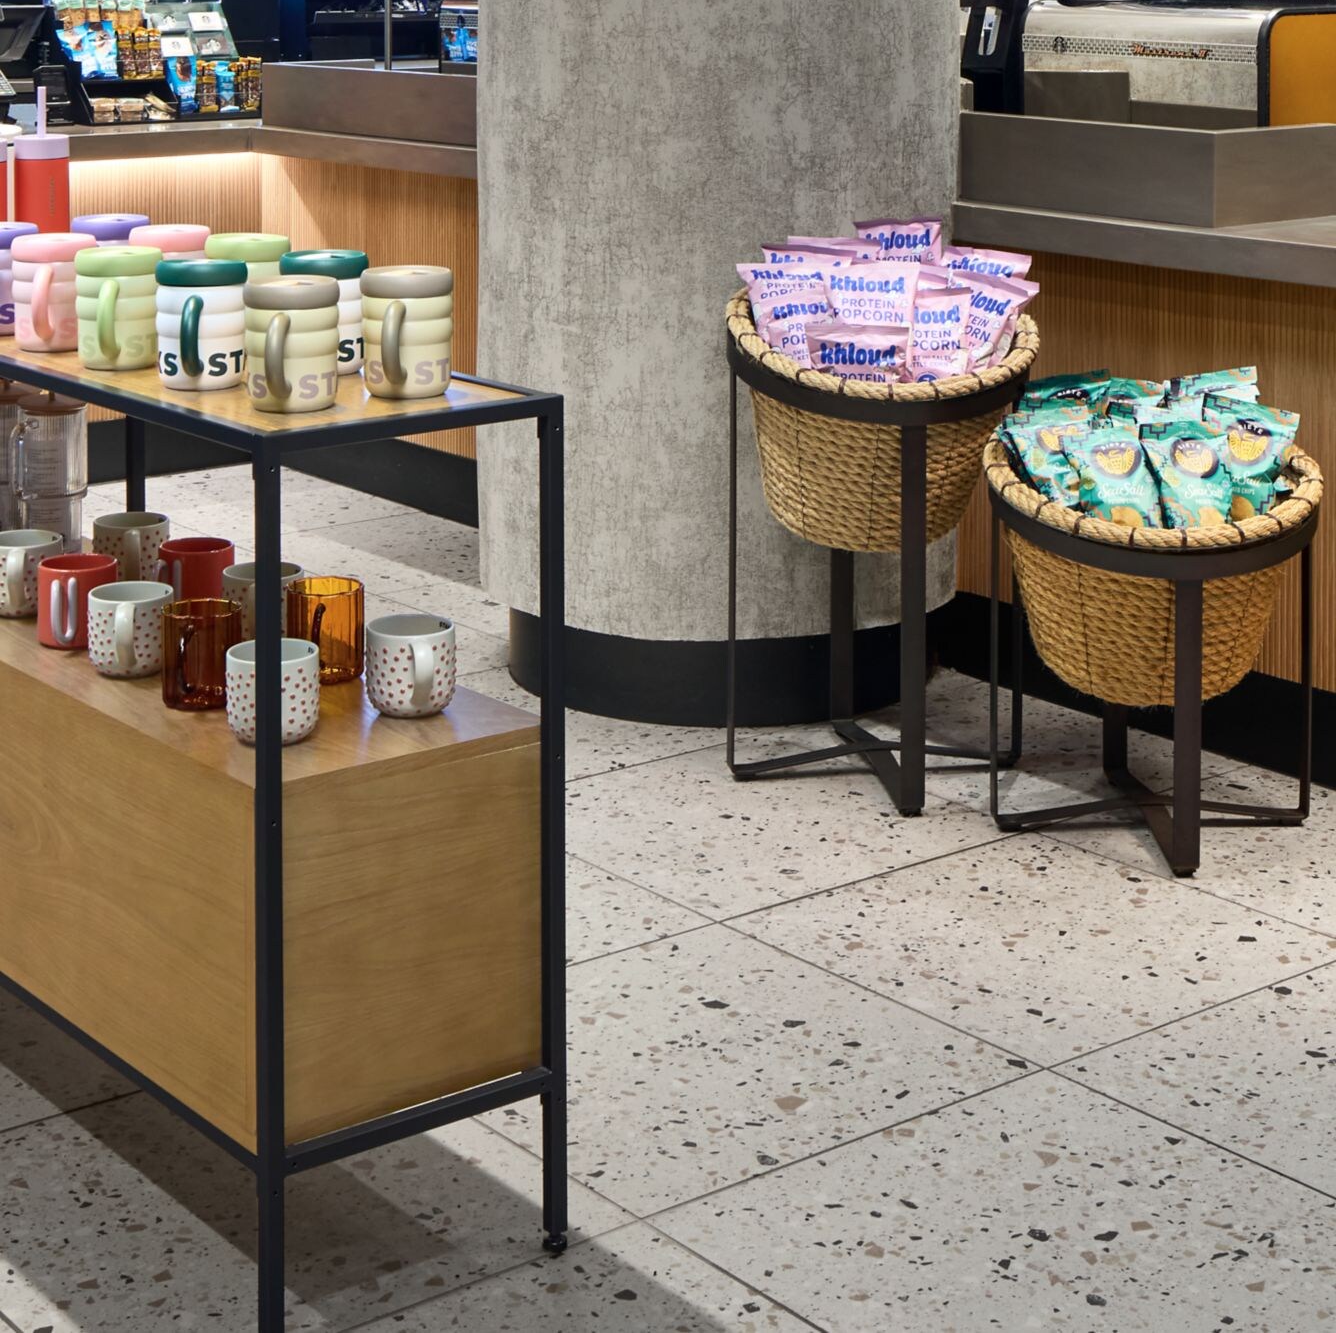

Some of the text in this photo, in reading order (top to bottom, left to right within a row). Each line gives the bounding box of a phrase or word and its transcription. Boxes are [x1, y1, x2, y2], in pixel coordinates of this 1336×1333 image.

[830, 274, 905, 294] khloud
[841, 297, 896, 309] PROTEIN
[833, 307, 904, 323] POPCORN
[820, 342, 896, 366] khloud
